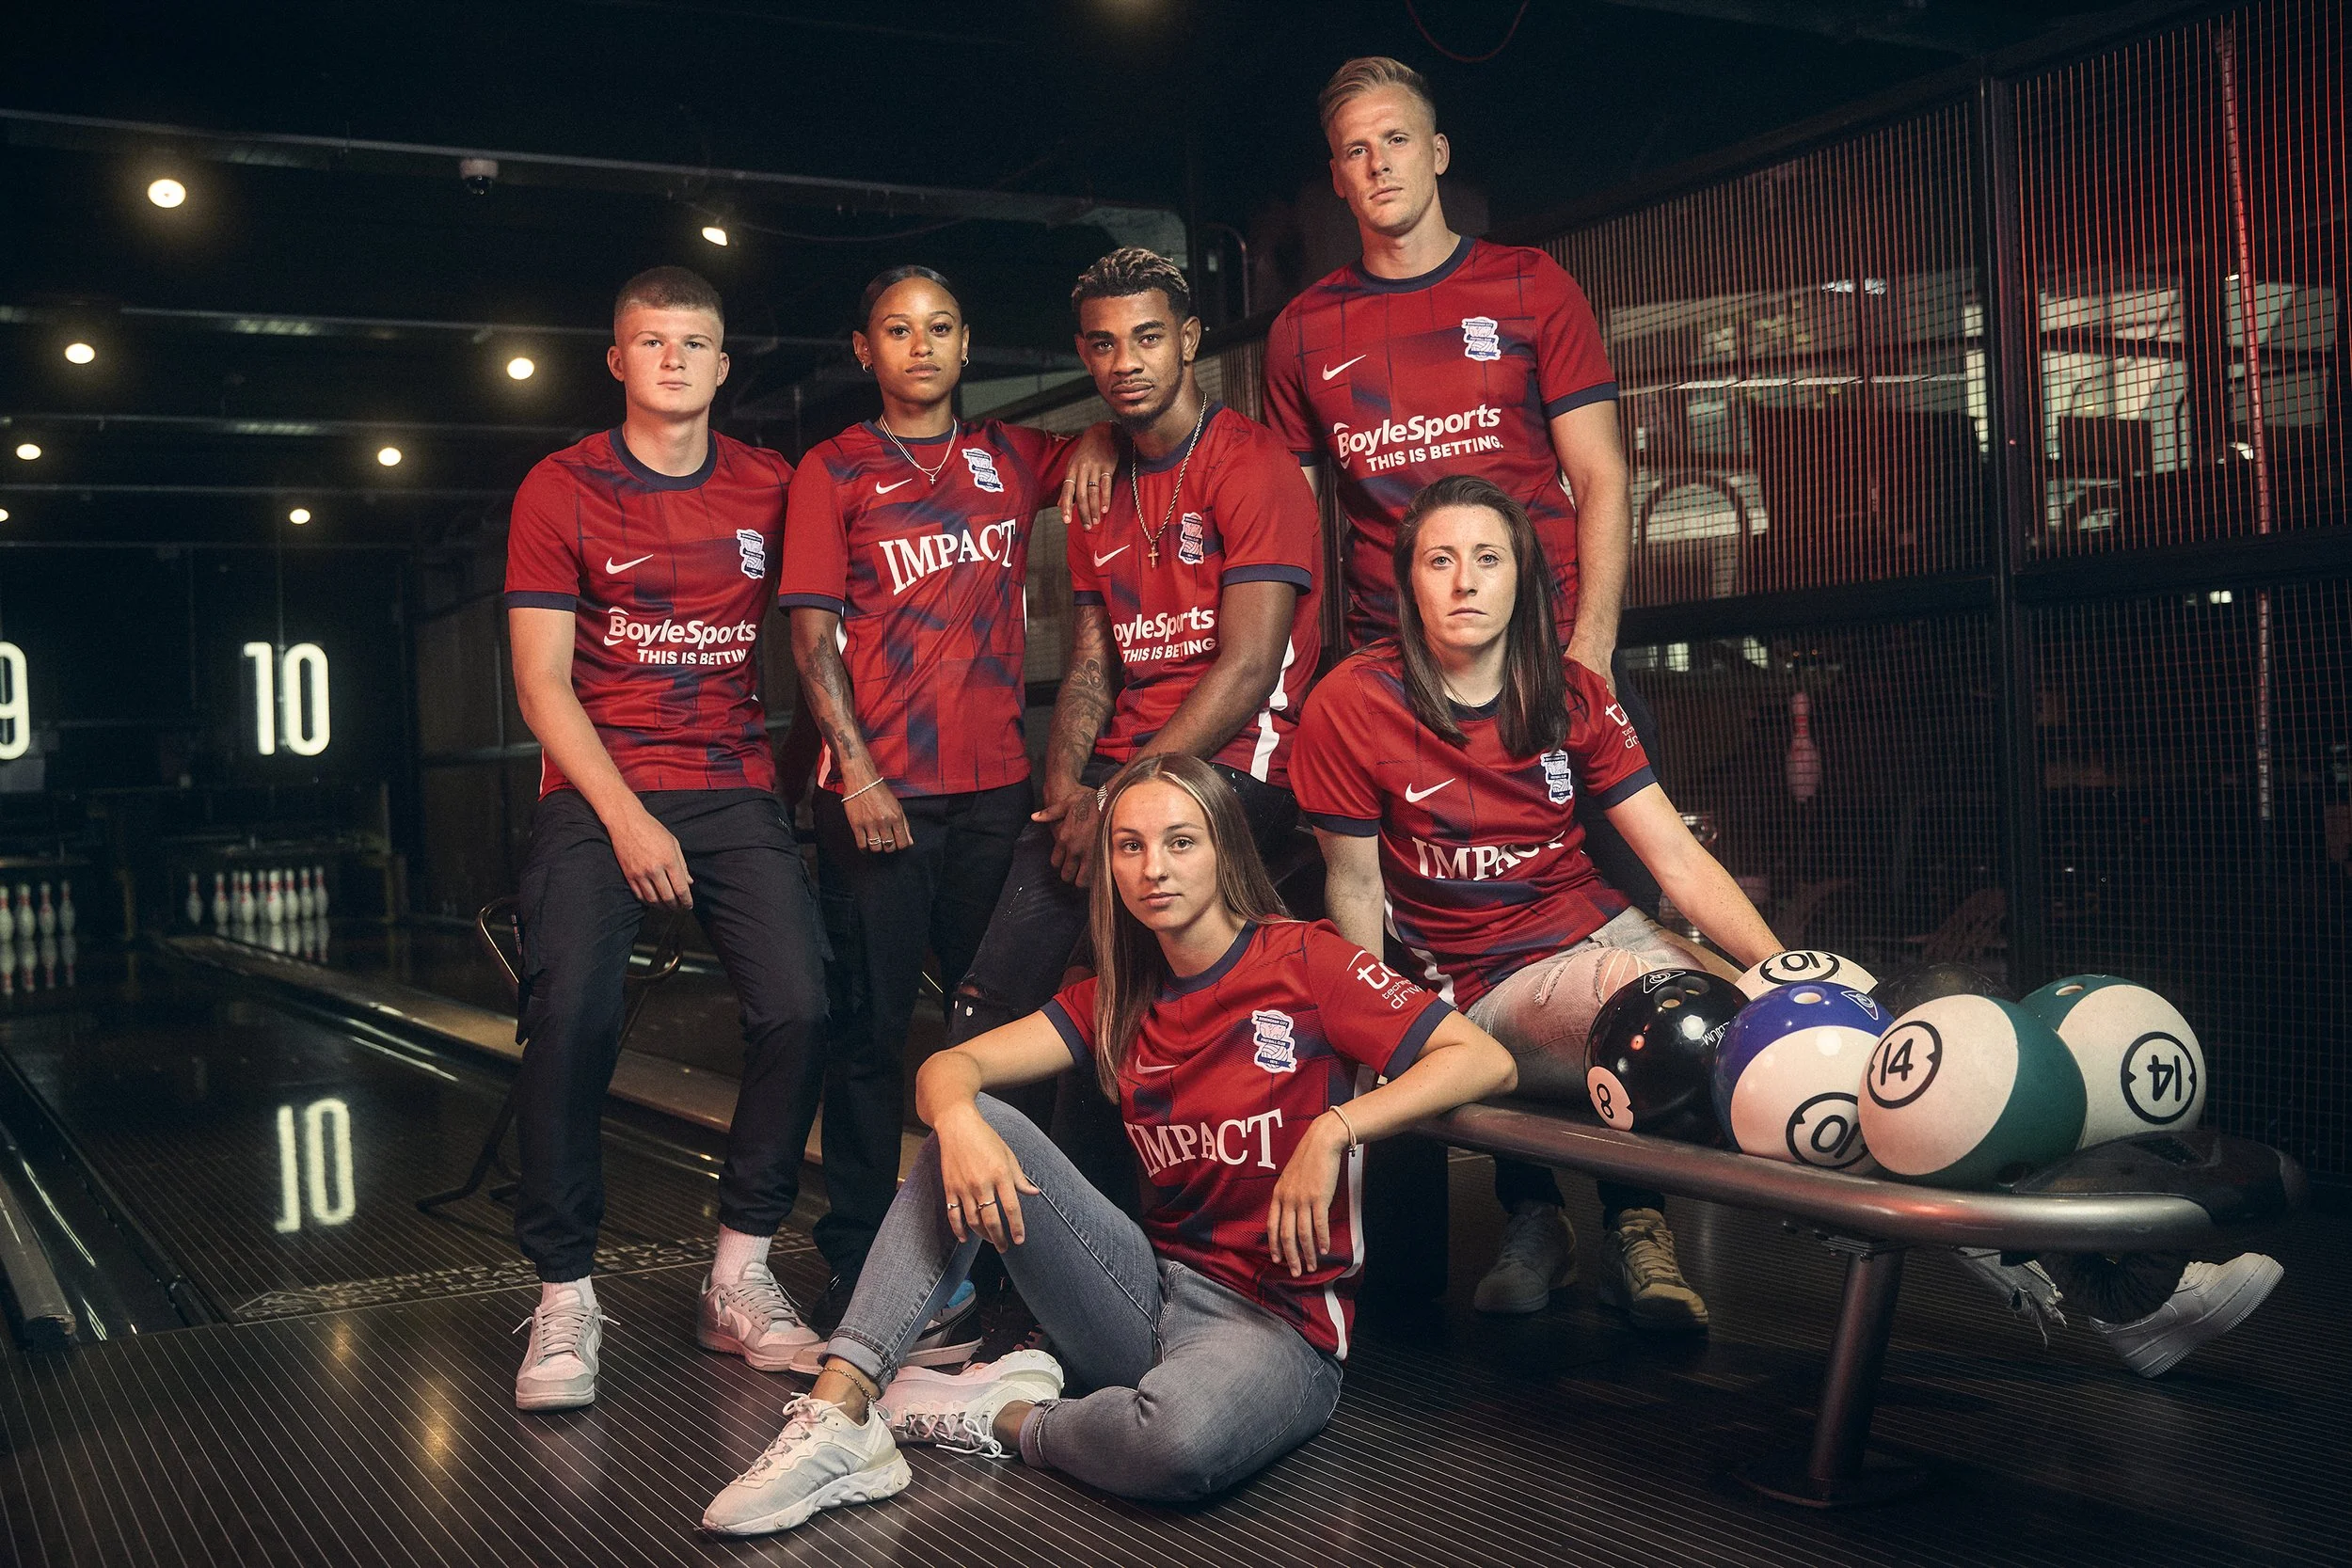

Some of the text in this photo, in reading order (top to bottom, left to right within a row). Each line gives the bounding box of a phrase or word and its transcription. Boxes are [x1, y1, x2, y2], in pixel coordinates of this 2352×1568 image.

[1333, 404, 1502, 469] BoyleSports
[1366, 450, 1406, 472] THIS
[1408, 448, 1426, 464] IS
[879, 518, 1016, 595] IMPACT
[603, 606, 756, 650] BoyleSports
[1113, 606, 1216, 647] oyleSports
[637, 648, 749, 666] THIS IS BETTIN
[1122, 647, 1150, 663] THIS
[1151, 645, 1164, 660] IS
[0, 641, 31, 761] 9
[243, 641, 330, 756] 10
[1411, 831, 1565, 881] IMPA
[1880, 1037, 1915, 1086] 14
[2147, 1054, 2182, 1102] 14
[1597, 1083, 1614, 1119] 8
[1123, 1108, 1283, 1178] IMPACT
[1810, 1115, 1861, 1159] 10
